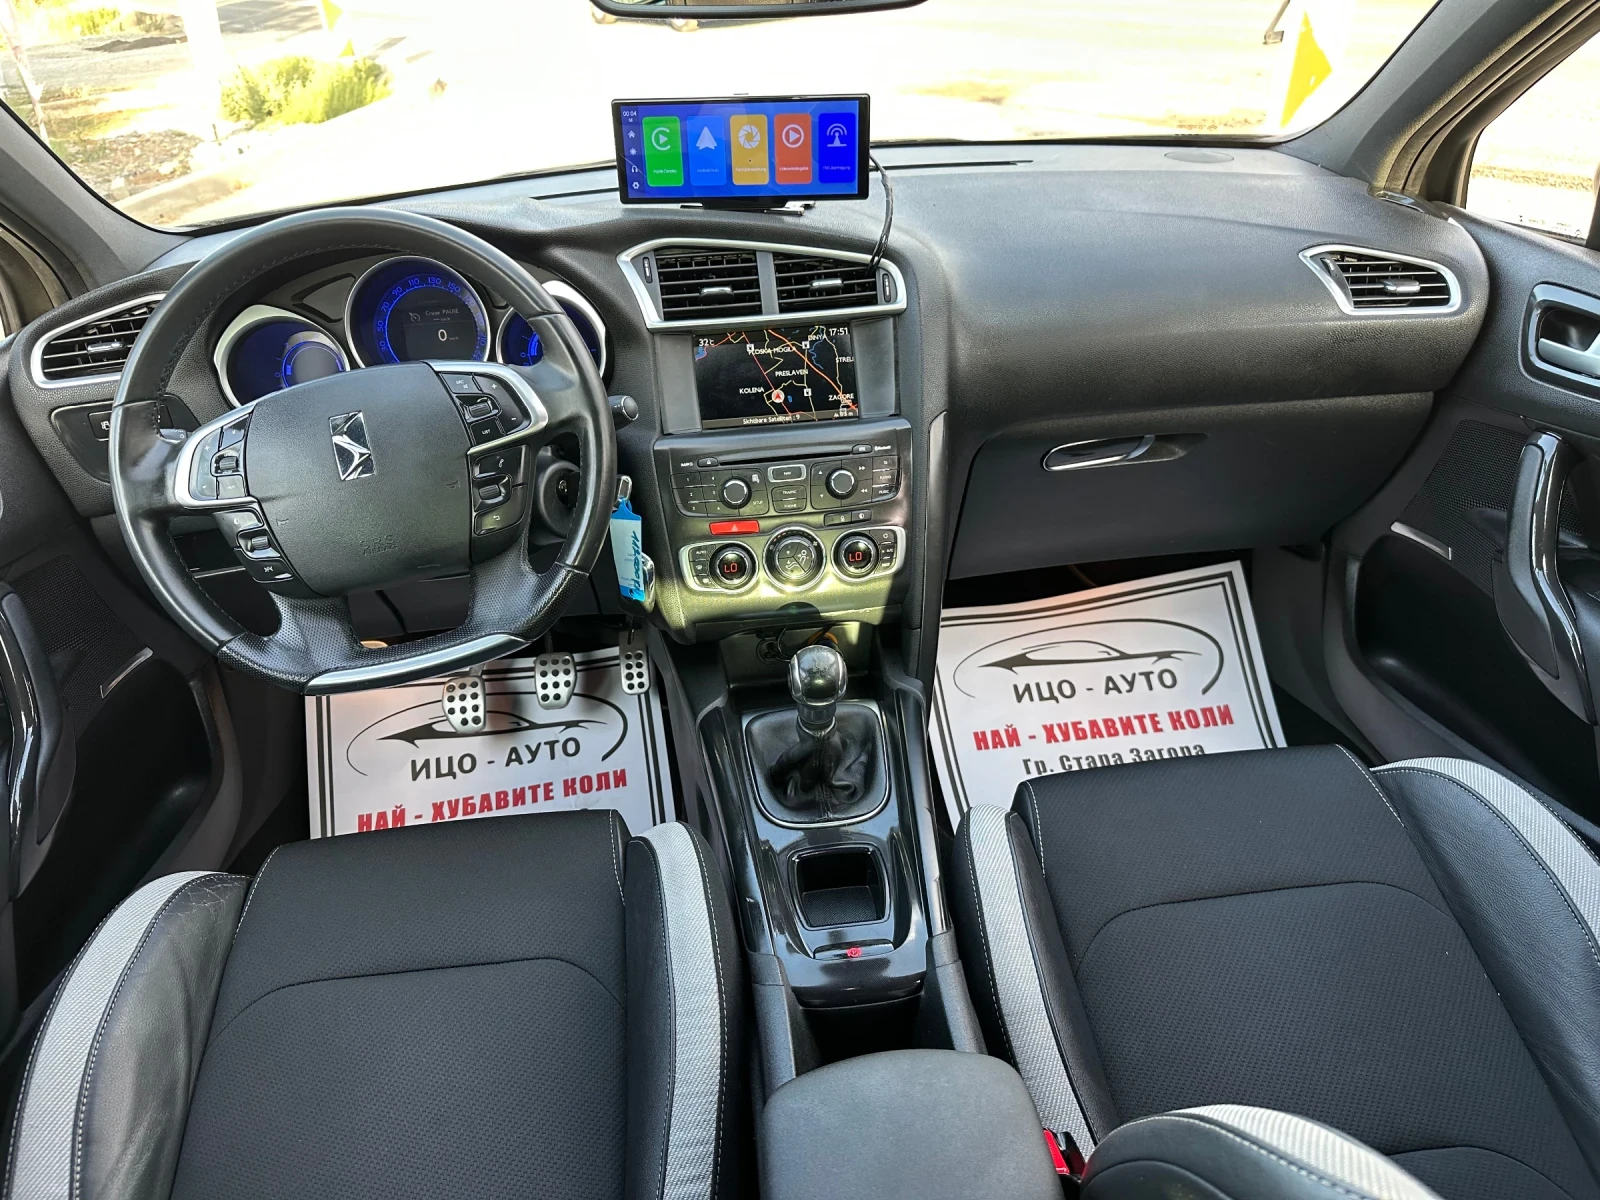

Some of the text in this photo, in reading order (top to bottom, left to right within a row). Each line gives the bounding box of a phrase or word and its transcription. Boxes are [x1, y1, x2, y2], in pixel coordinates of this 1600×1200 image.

[408, 278, 420, 287] 110
[427, 276, 442, 285] 130
[391, 286, 403, 296] 90
[447, 281, 461, 293] 150
[380, 301, 390, 312] 70
[377, 320, 384, 332] 50
[829, 327, 848, 337] 17:51
[438, 329, 448, 342] 0
[379, 340, 387, 352] 30
[775, 369, 809, 377] PRESLAVEN
[739, 386, 765, 395] KOLENA
[1012, 678, 1076, 705] ИЦО
[1103, 668, 1178, 696] АУТО
[972, 723, 1022, 751] НАЙ
[1044, 712, 1164, 744] ХУБАВИТЕ
[1167, 703, 1235, 732] КОЛИ
[410, 752, 477, 782] ИЦО
[504, 736, 581, 767] АУТО
[1022, 743, 1206, 776] Гр. Стара Загора
[357, 803, 406, 833] НАЙ
[431, 781, 554, 822] ХУБАВИТЕ
[563, 768, 627, 797] КОЛИ
